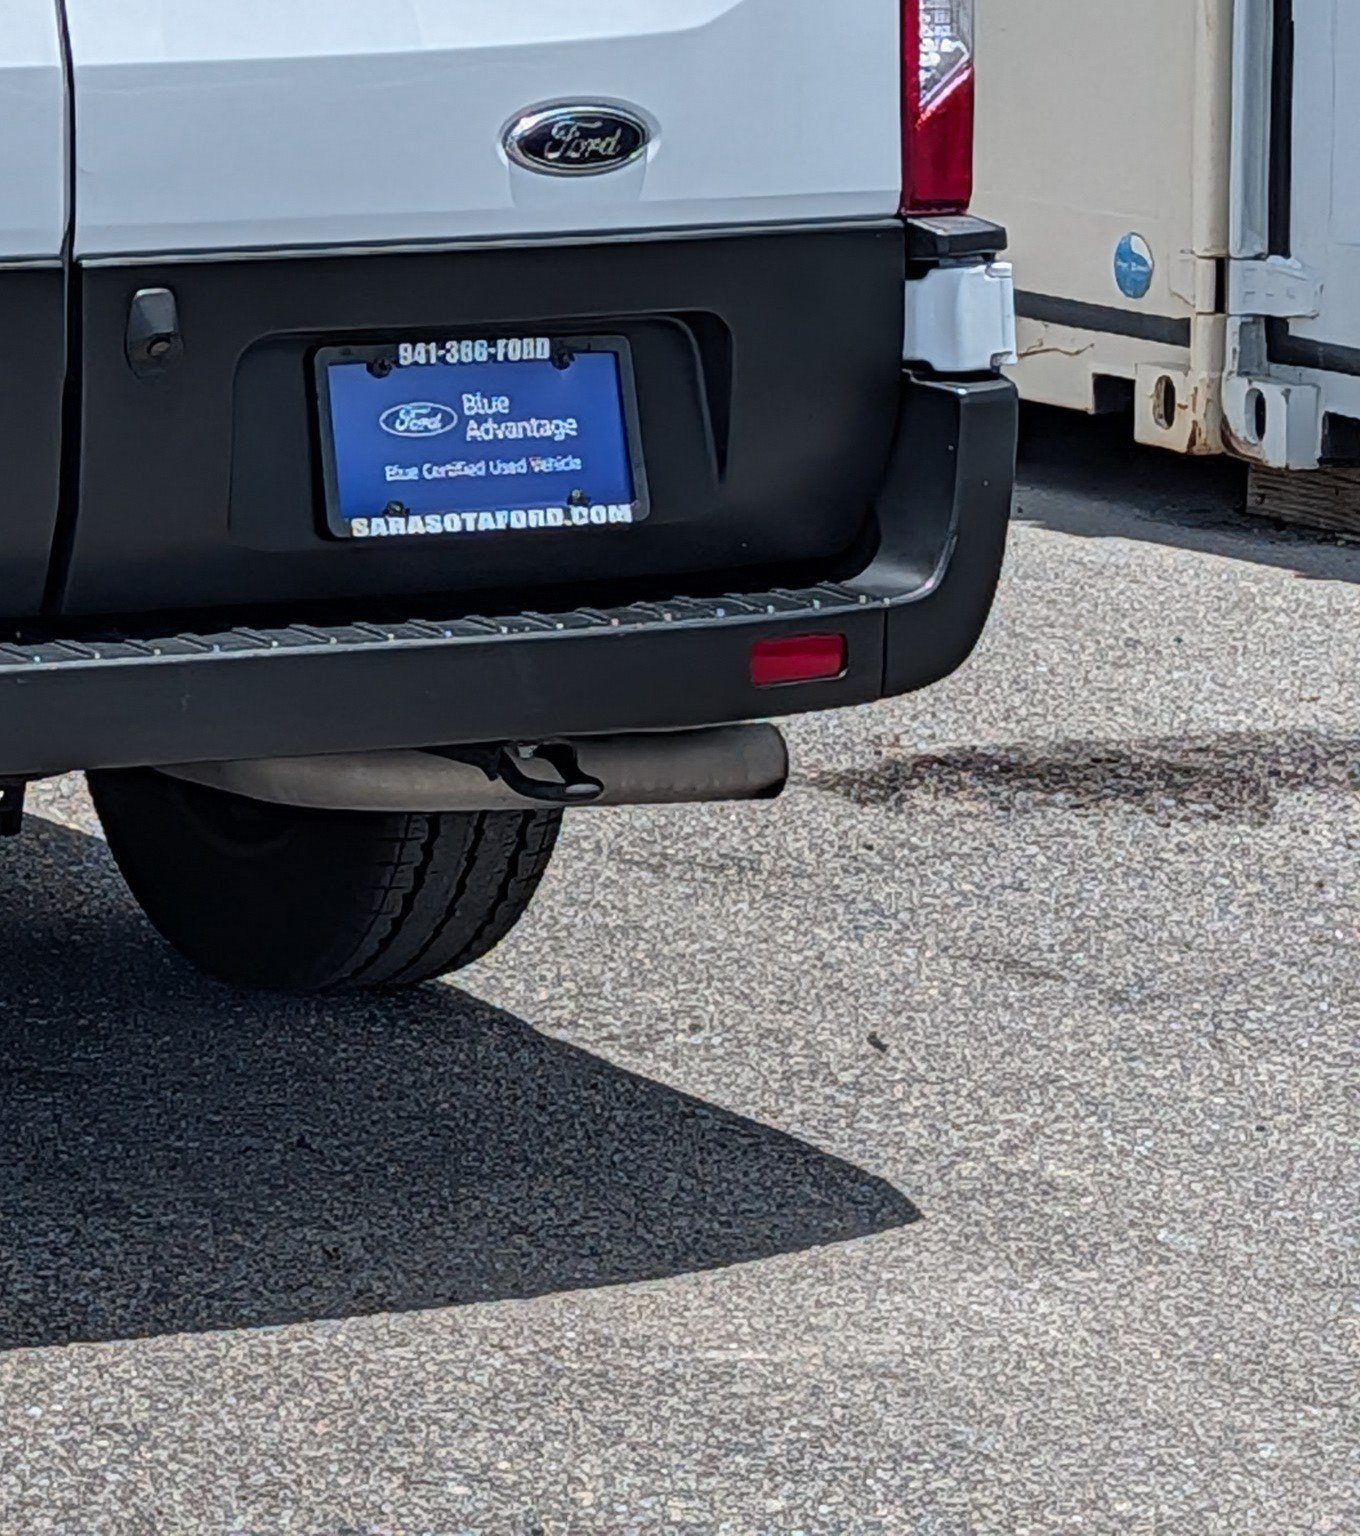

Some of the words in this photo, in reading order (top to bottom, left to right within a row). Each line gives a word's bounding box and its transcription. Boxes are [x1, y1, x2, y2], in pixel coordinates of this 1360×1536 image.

[543, 119, 623, 161] Ford
[461, 392, 510, 416] Blue
[394, 404, 444, 433] Ford
[465, 417, 579, 443] Advantage
[384, 464, 419, 482] Blue
[489, 458, 527, 476] Used
[529, 454, 582, 474] Vehicle
[350, 503, 634, 539] SARASOTAFORD.COM
